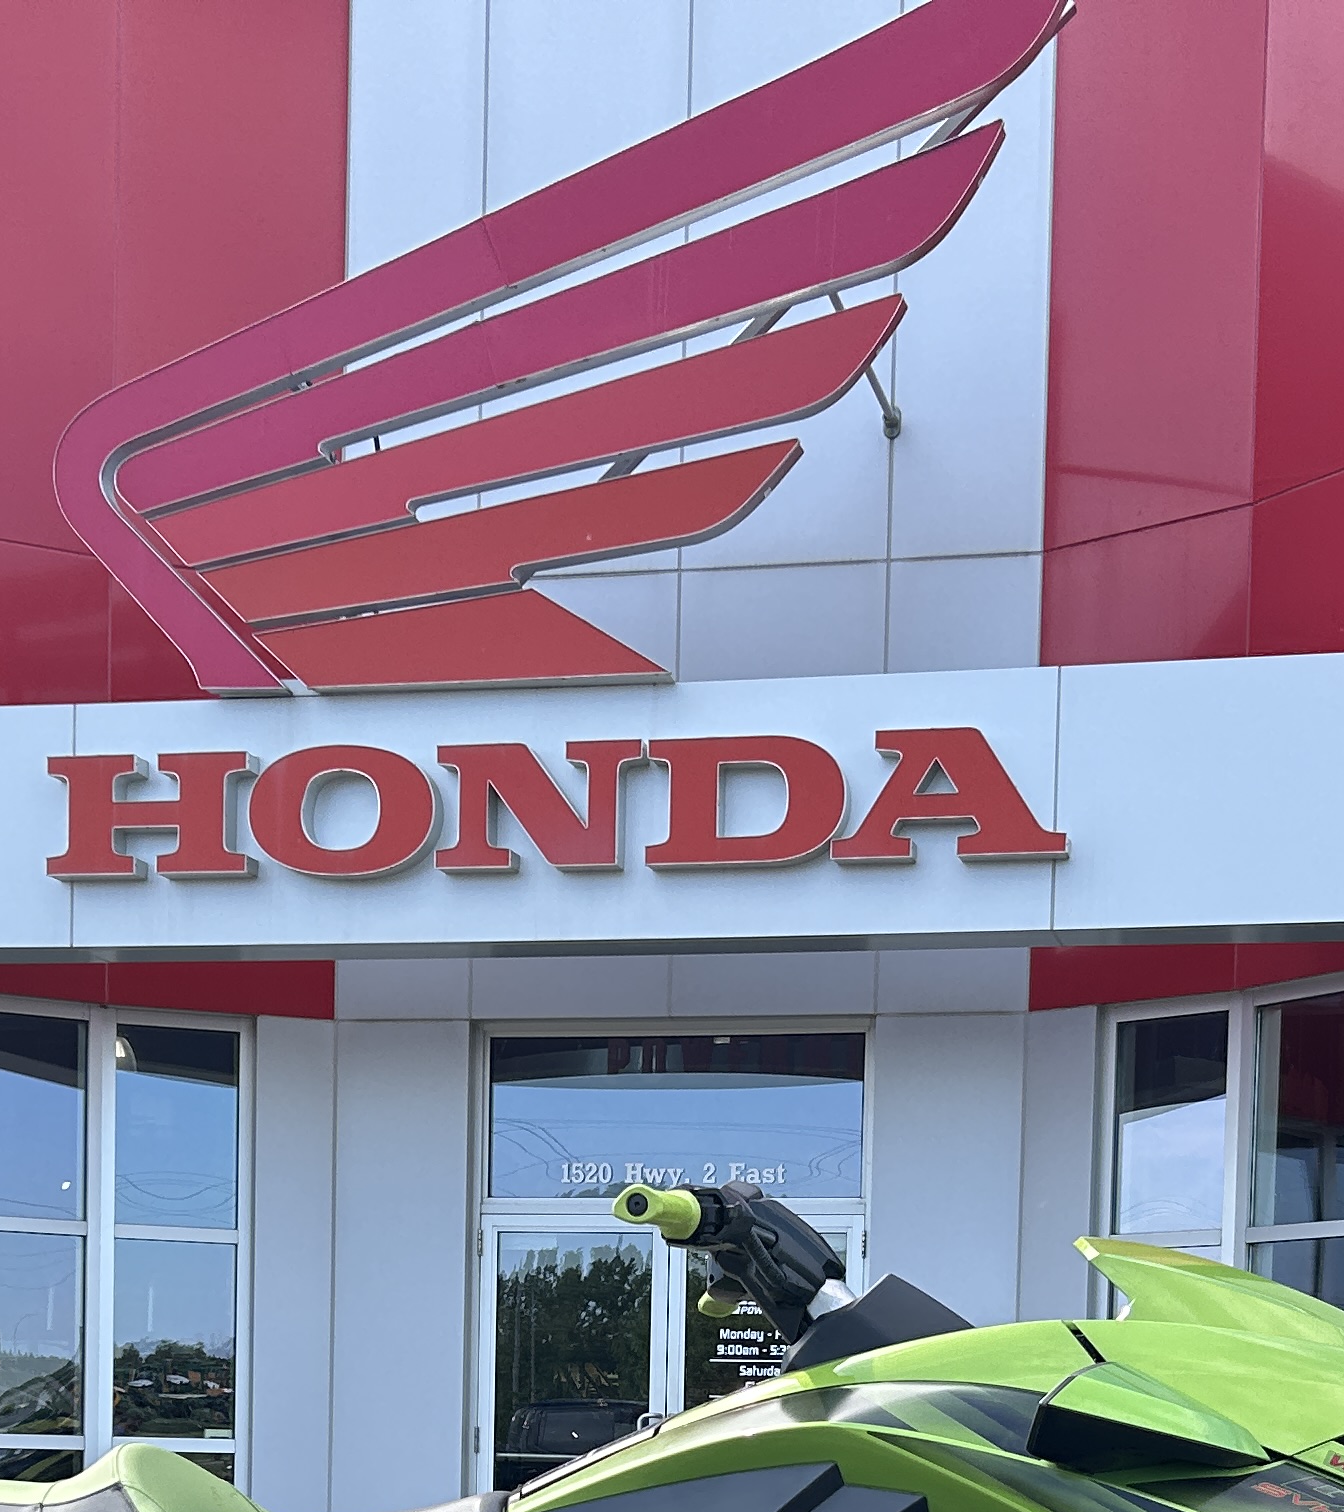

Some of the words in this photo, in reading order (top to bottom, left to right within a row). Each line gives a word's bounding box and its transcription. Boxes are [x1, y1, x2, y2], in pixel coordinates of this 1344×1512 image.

[45, 726, 1070, 880] HONDA
[560, 1162, 614, 1184] 1520
[702, 1162, 718, 1184] 2
[729, 1162, 786, 1184] East
[719, 1328, 765, 1343] Monday
[716, 1344, 760, 1356] 9:00am
[769, 1344, 791, 1356] 5:3
[739, 1365, 781, 1377] Saturda
